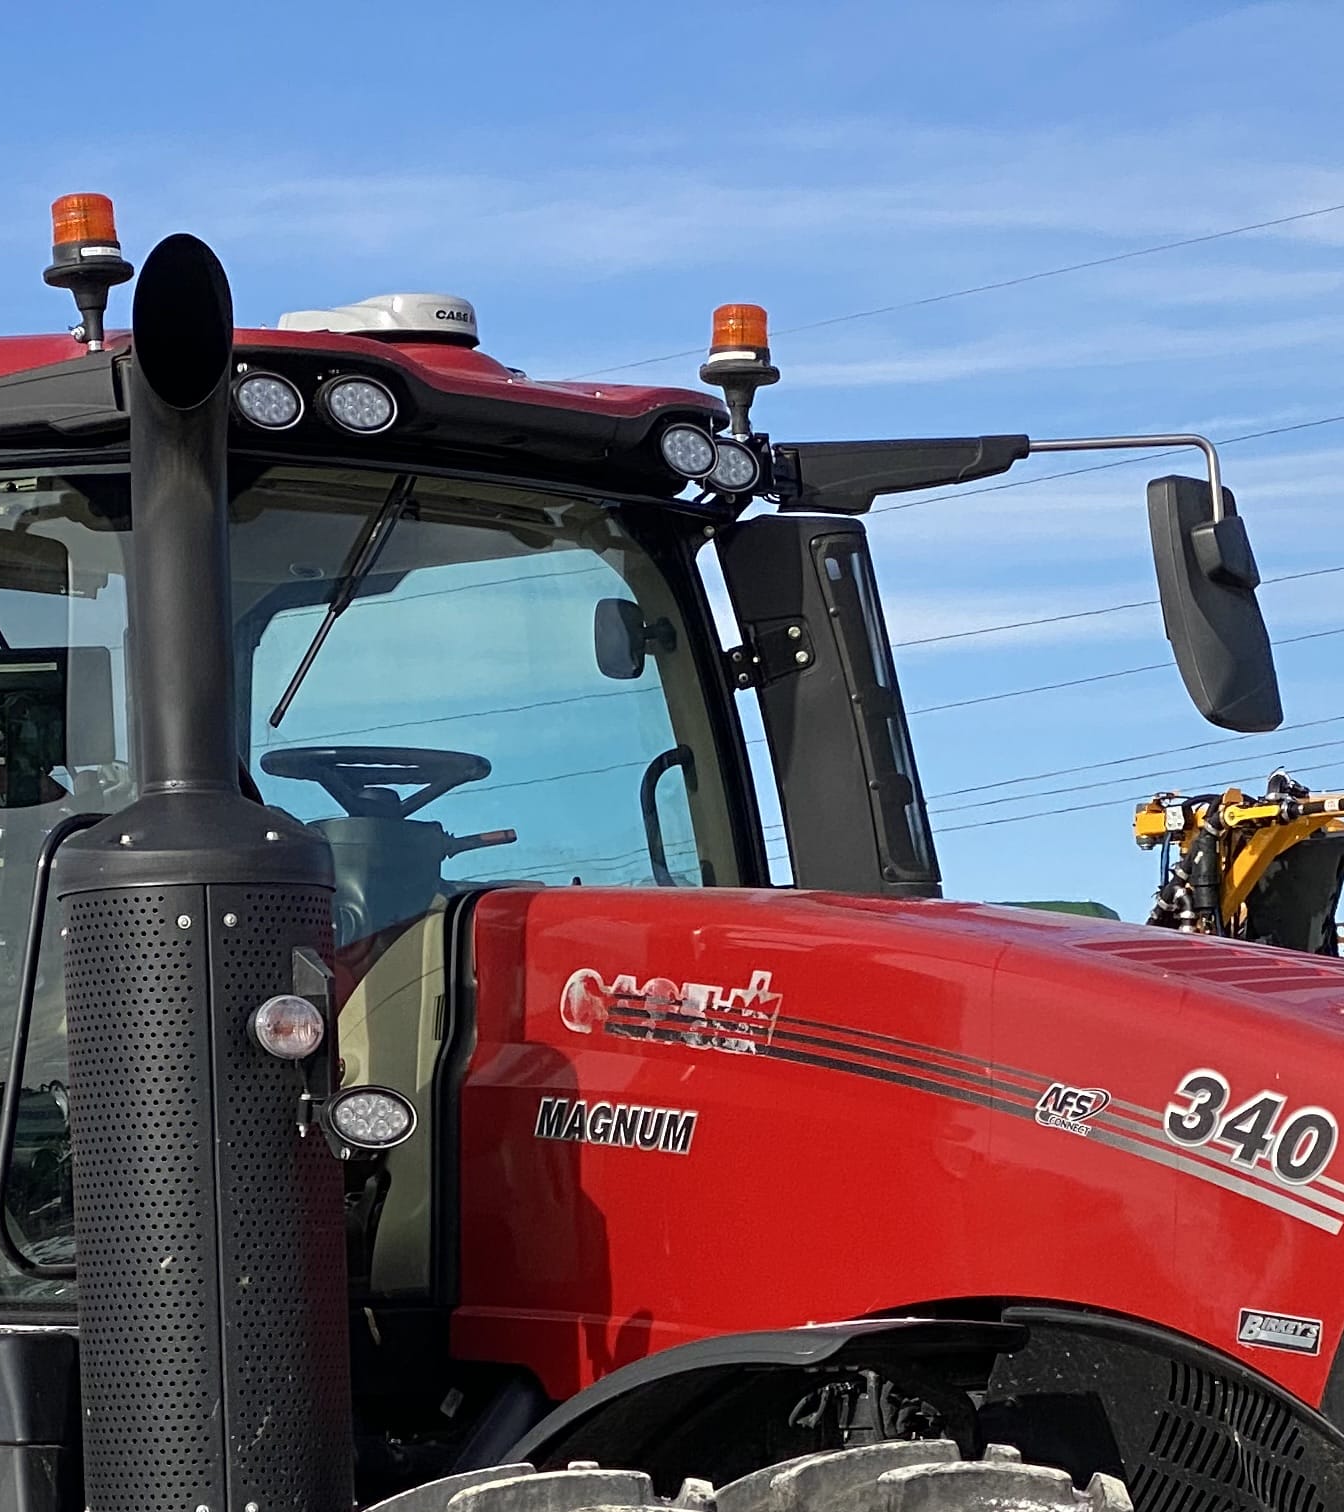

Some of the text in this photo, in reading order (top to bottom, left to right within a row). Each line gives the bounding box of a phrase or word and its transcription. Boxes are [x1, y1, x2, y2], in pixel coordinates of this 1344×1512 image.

[1039, 1084, 1095, 1118] AFS
[534, 1097, 698, 1155] MAGNUM
[1049, 1115, 1091, 1136] CONNECT
[1164, 1068, 1339, 1186] 340
